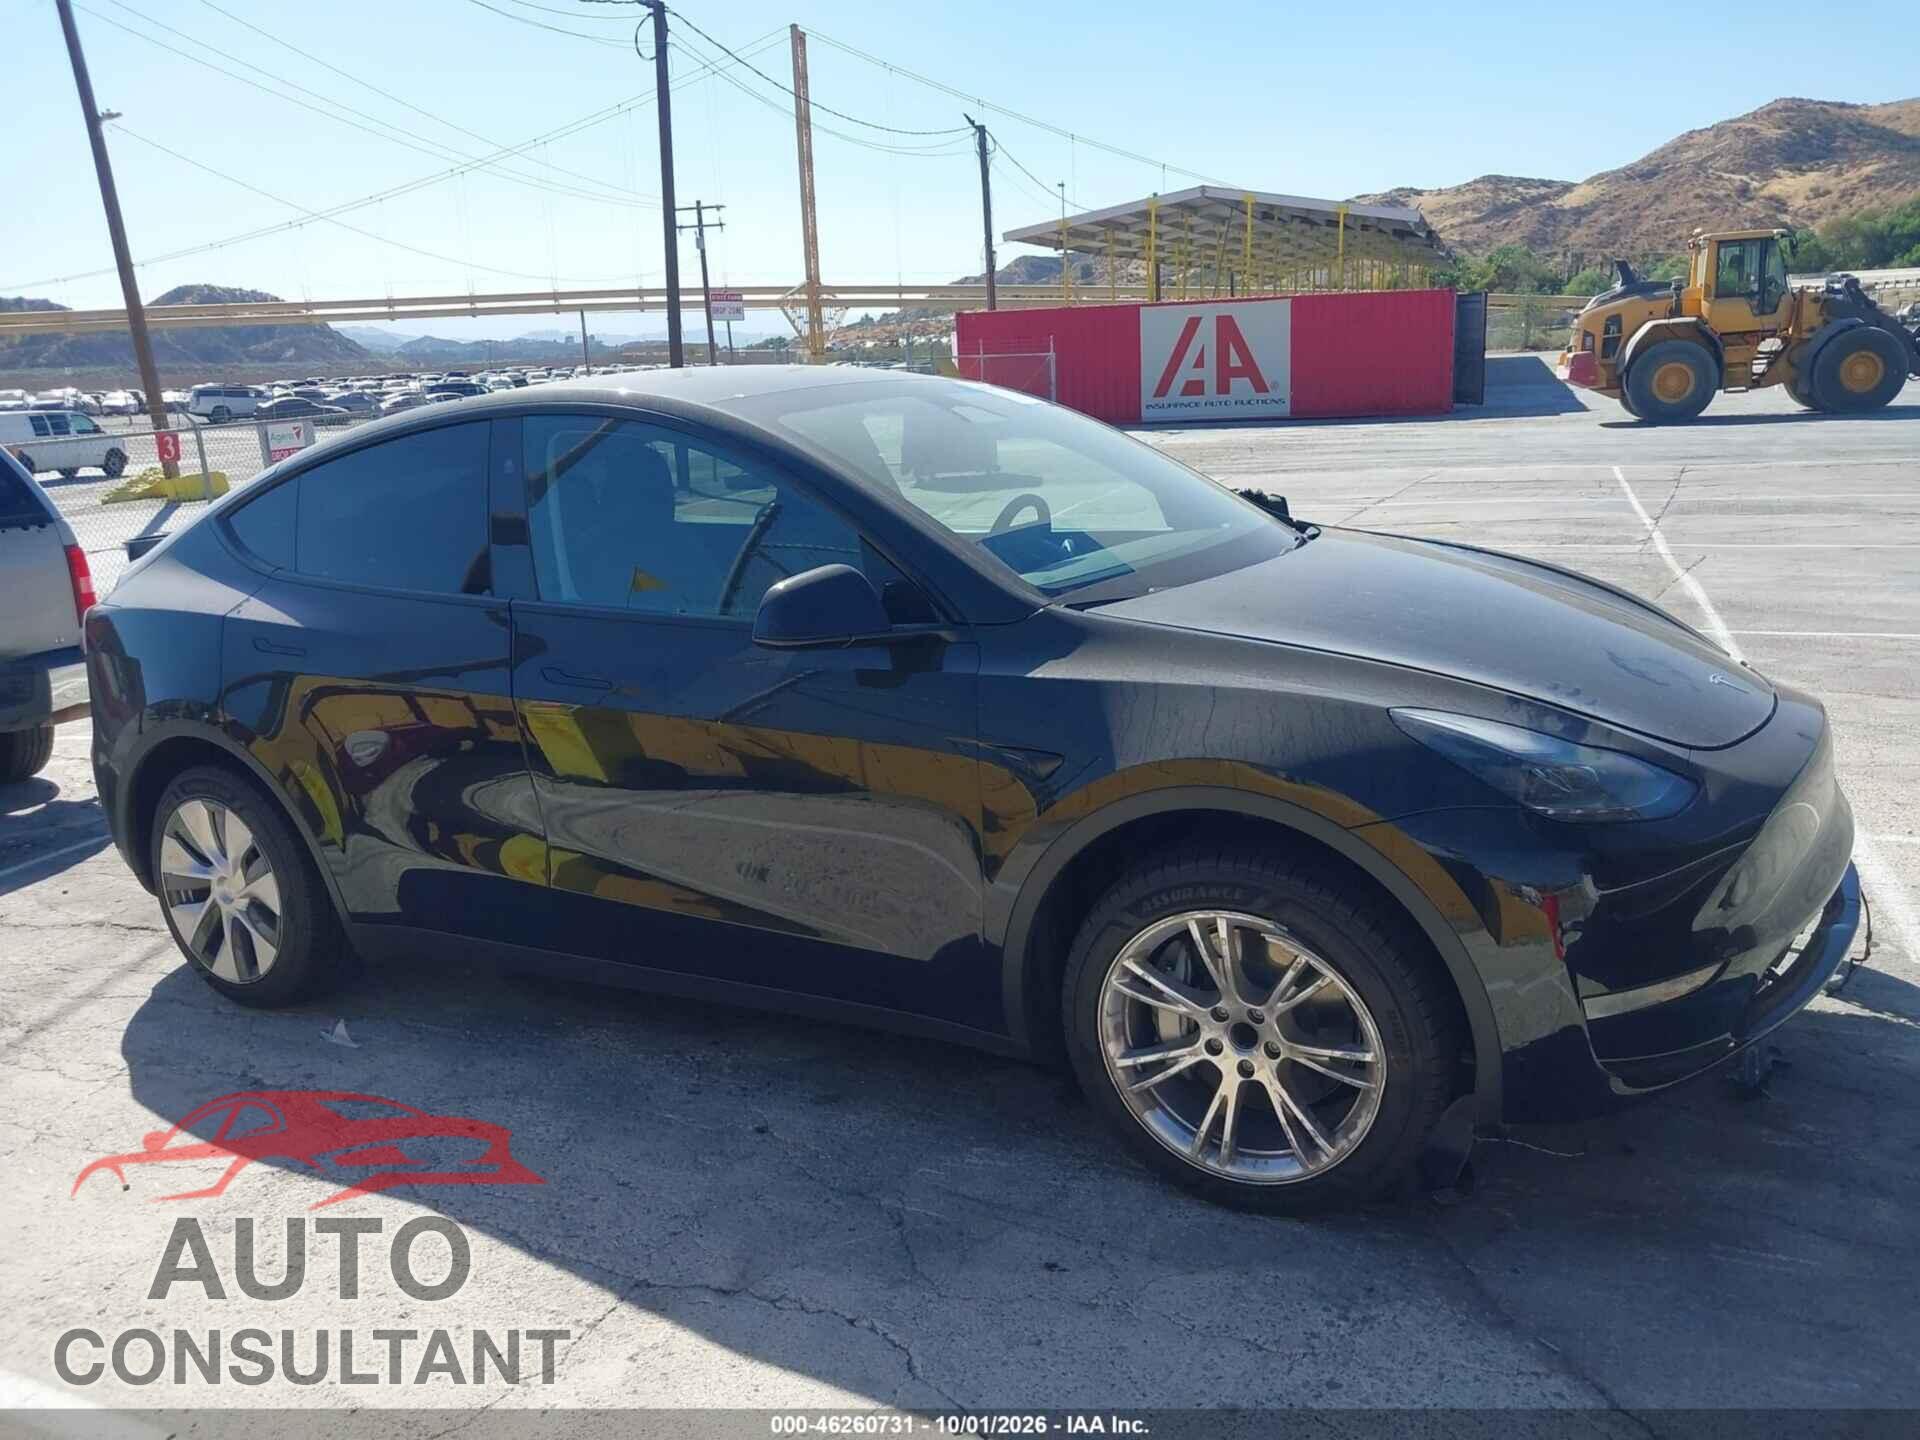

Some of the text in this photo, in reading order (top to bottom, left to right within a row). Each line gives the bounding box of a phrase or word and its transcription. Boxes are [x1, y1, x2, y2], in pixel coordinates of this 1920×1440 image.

[1145, 398, 1286, 410] INSURANCE AUTO AUCTIONS
[163, 435, 175, 460] 3
[1140, 886, 1245, 913] ASSURANCE
